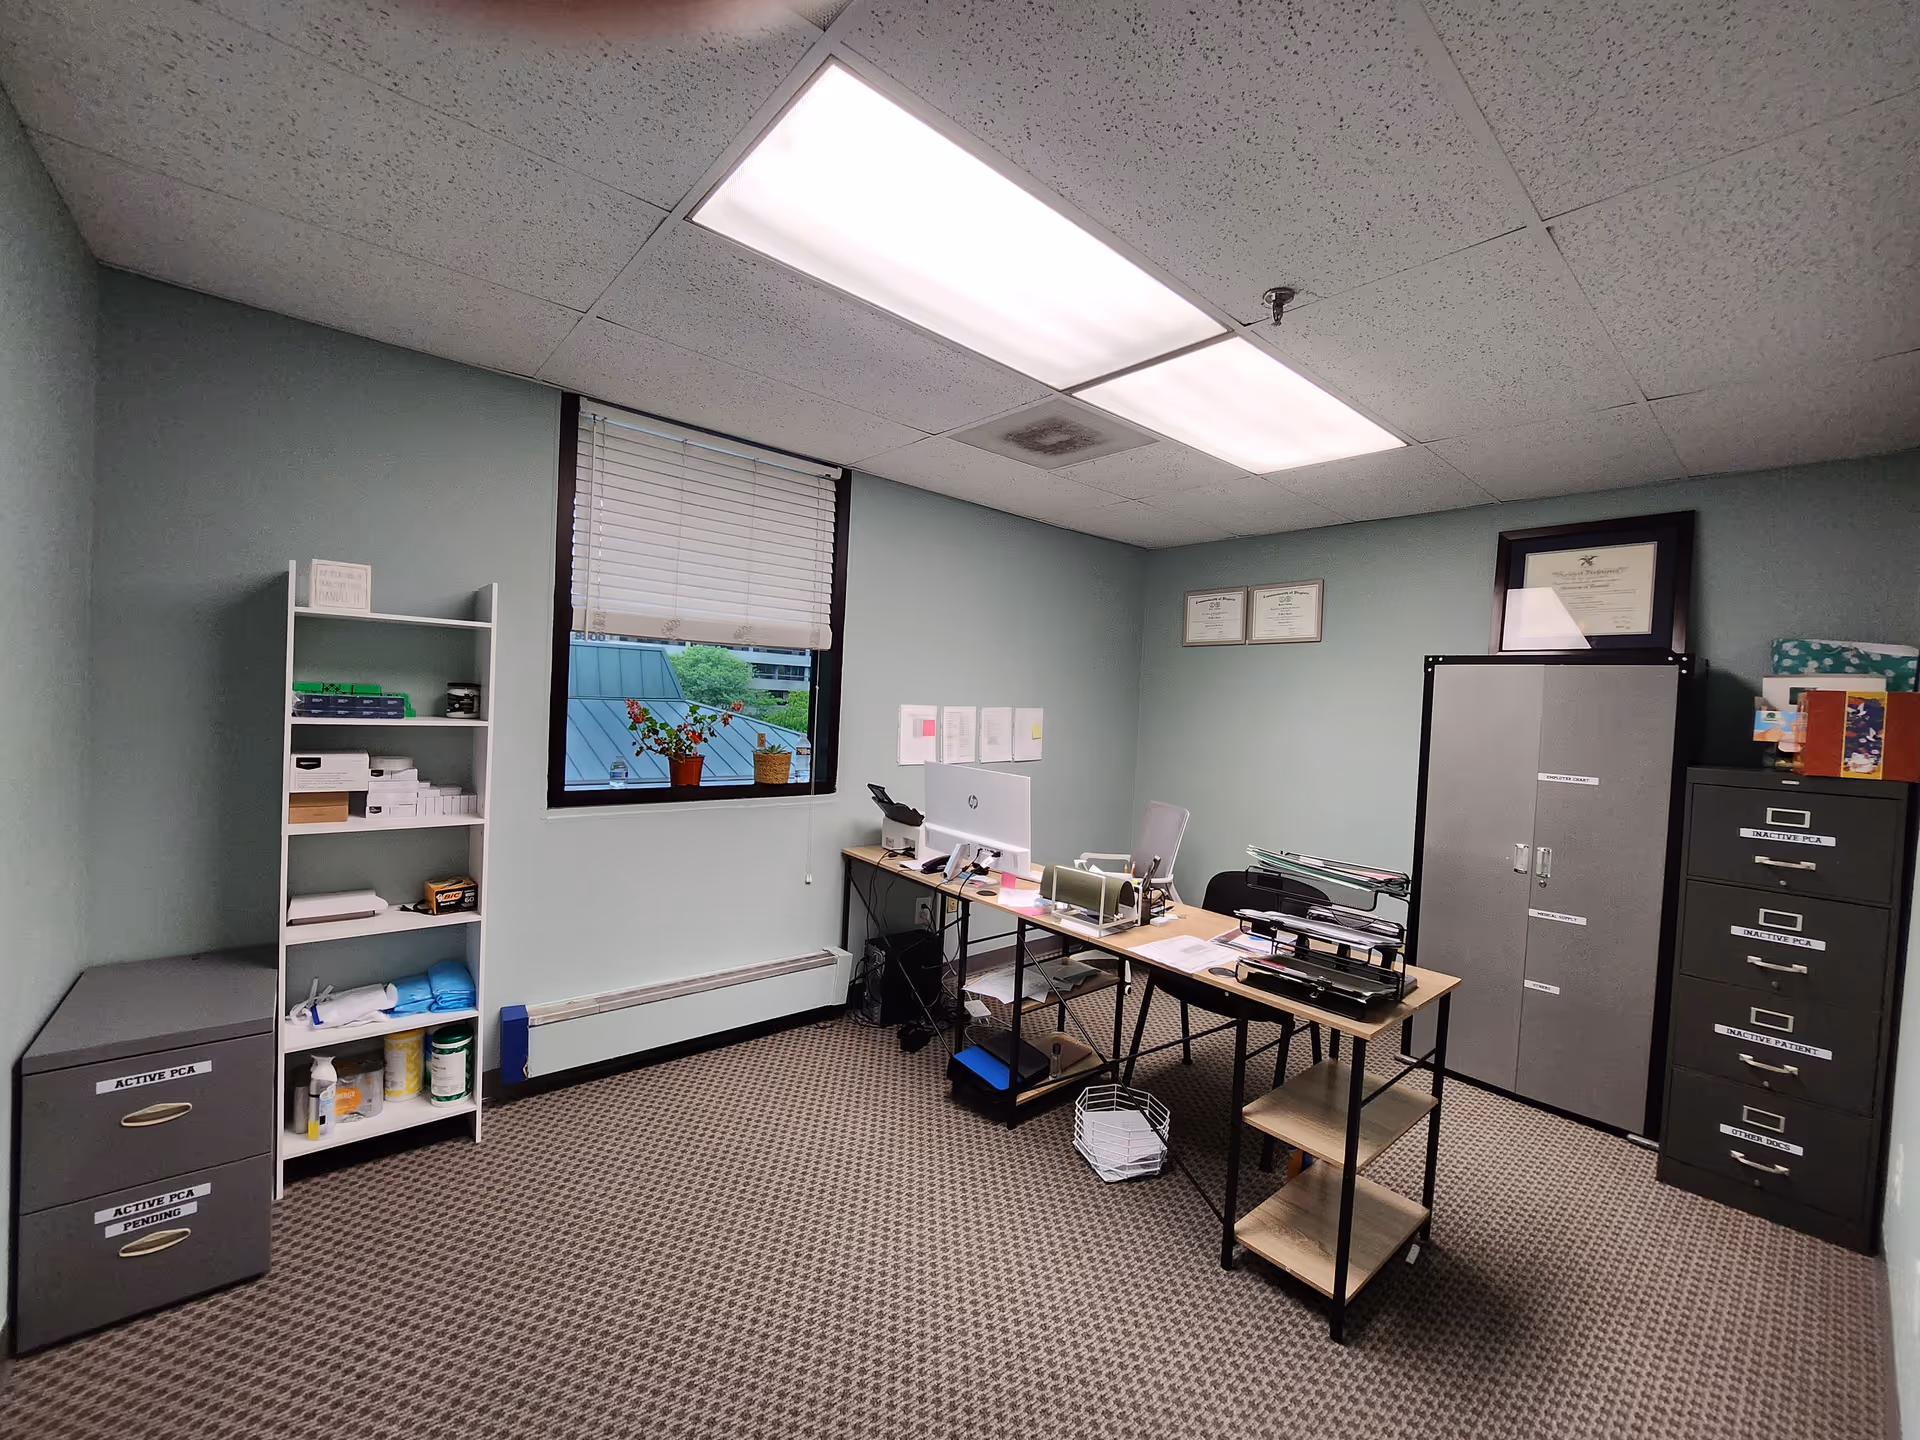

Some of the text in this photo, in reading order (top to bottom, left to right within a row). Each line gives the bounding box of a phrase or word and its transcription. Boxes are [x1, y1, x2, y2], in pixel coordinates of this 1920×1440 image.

[1752, 830, 1822, 844] INACTIVE PCA
[443, 891, 461, 900] BIC
[1743, 929, 1812, 947] INACTIVE PCA
[1726, 1027, 1818, 1055] INACTIVE PATIENT
[114, 1065, 195, 1089] ACTIVE PCA
[1731, 1128, 1791, 1151] OTHER DOCS
[113, 1189, 195, 1217] ACTIVE PCA
[122, 1207, 182, 1231] PENDING
